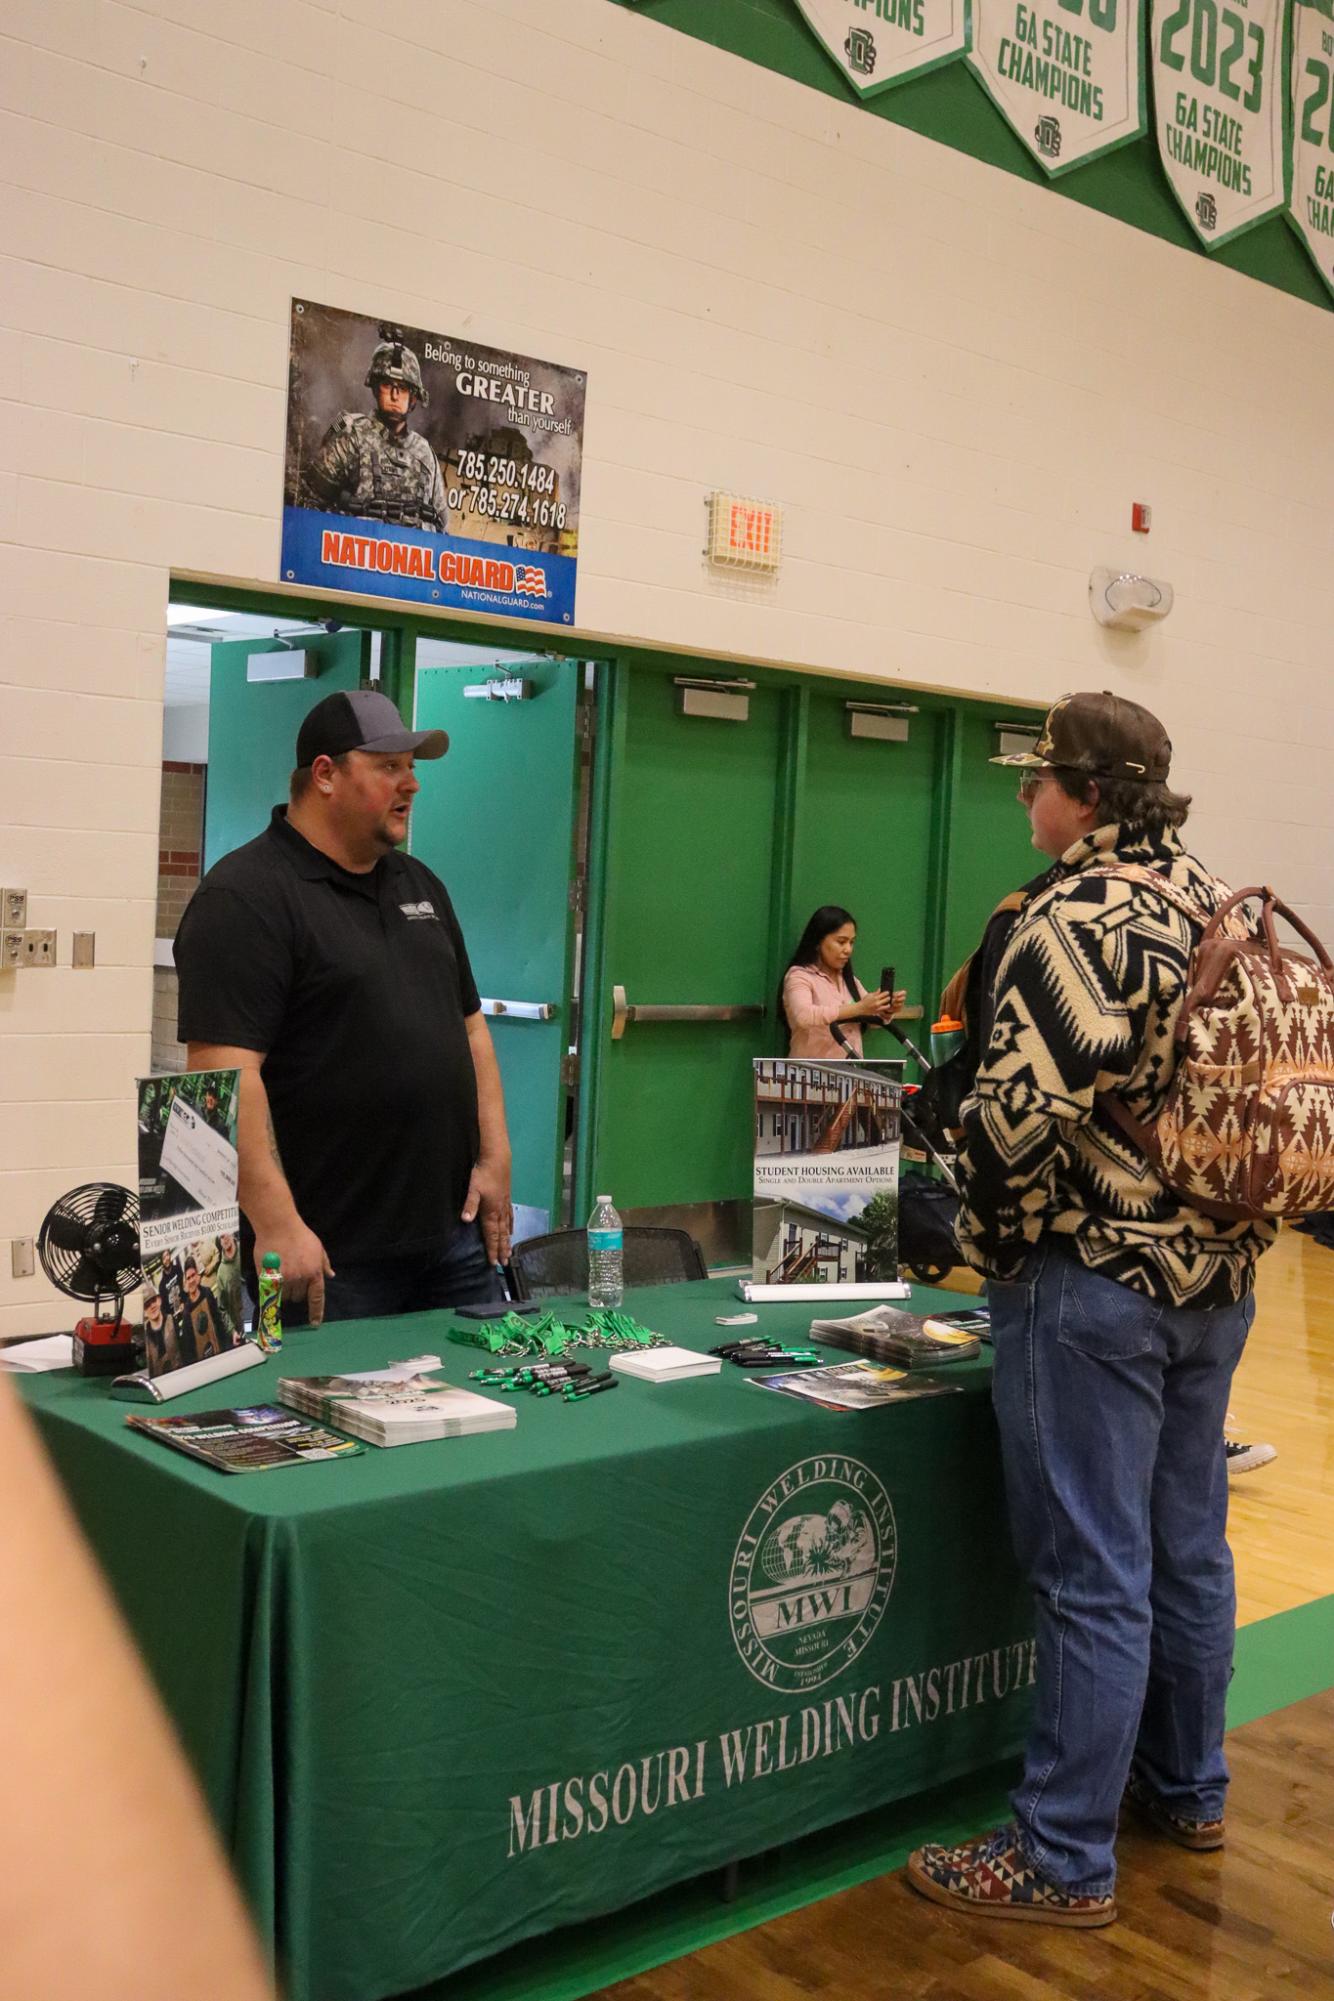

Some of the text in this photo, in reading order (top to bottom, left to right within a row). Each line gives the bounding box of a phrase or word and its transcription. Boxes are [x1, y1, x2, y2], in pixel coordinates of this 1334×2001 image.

[1016, 3, 1037, 50] 6A
[1042, 19, 1093, 78] STATE
[1160, 0, 1265, 114] 2023
[997, 37, 1104, 122] CHAMPIONS
[1175, 91, 1243, 157] 6A STATE
[1166, 122, 1252, 197] CHAMPIONS
[424, 342, 530, 388] Belong to something
[455, 371, 555, 417] GREATER
[507, 404, 573, 437] than yourself
[456, 448, 556, 496] 785.250.1484
[447, 485, 568, 531] or 785.274.1618
[729, 503, 773, 555] EXIT
[321, 529, 515, 594] NATIONAL GUARD
[461, 589, 546, 611] NATIONALGUARD.com
[755, 1165, 895, 1176] STUDENT HOUSING AVAILABLE
[142, 1222, 172, 1239] SENIOR
[171, 1214, 201, 1232] WELDING
[731, 1458, 897, 1684] MISSOURI WELDING INSTITUTE
[774, 1583, 856, 1631] MWI
[506, 1739, 709, 1859] MISSOURI
[718, 1685, 882, 1790] WELDING
